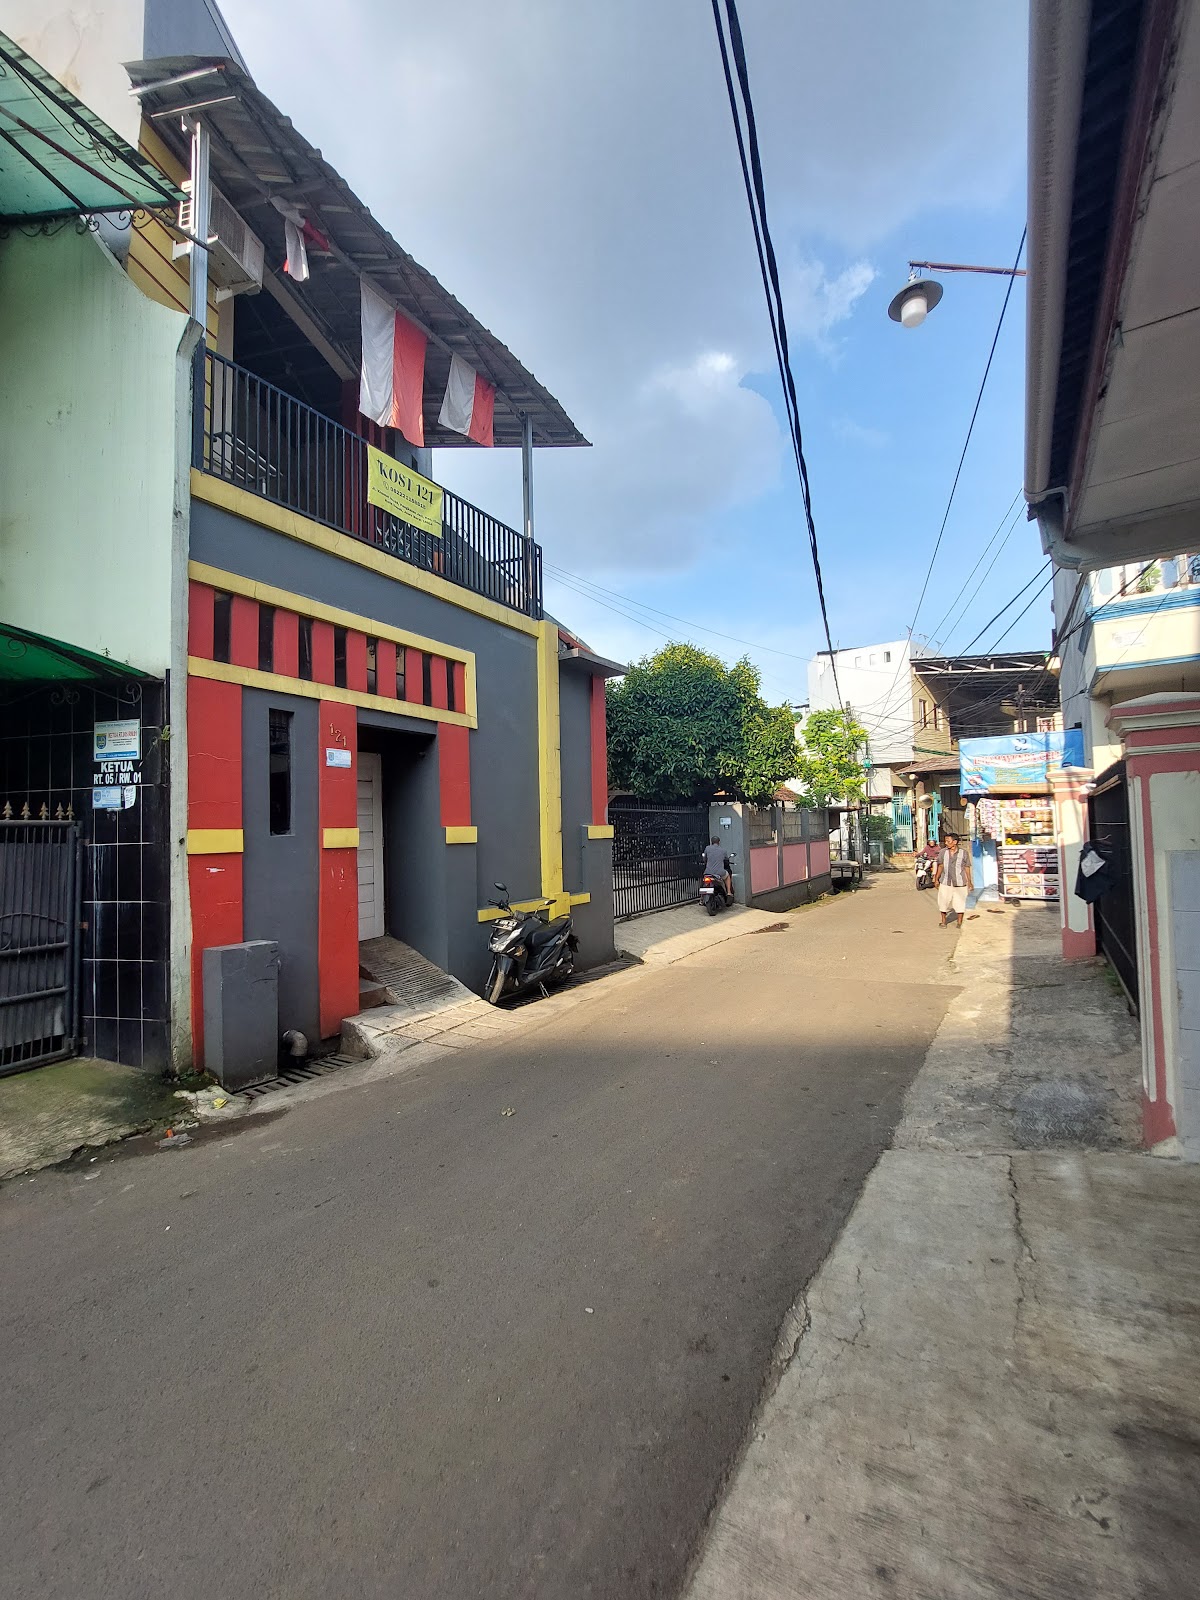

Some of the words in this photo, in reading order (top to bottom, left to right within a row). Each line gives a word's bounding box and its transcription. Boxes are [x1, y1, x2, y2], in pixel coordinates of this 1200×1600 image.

[377, 459, 413, 491] KOST
[416, 484, 433, 505] 121
[330, 722, 347, 747] 121
[100, 761, 134, 773] KETUA
[93, 773, 104, 785] RT.
[105, 773, 114, 784] 05
[119, 772, 132, 784] RW.
[133, 772, 142, 783] 01
